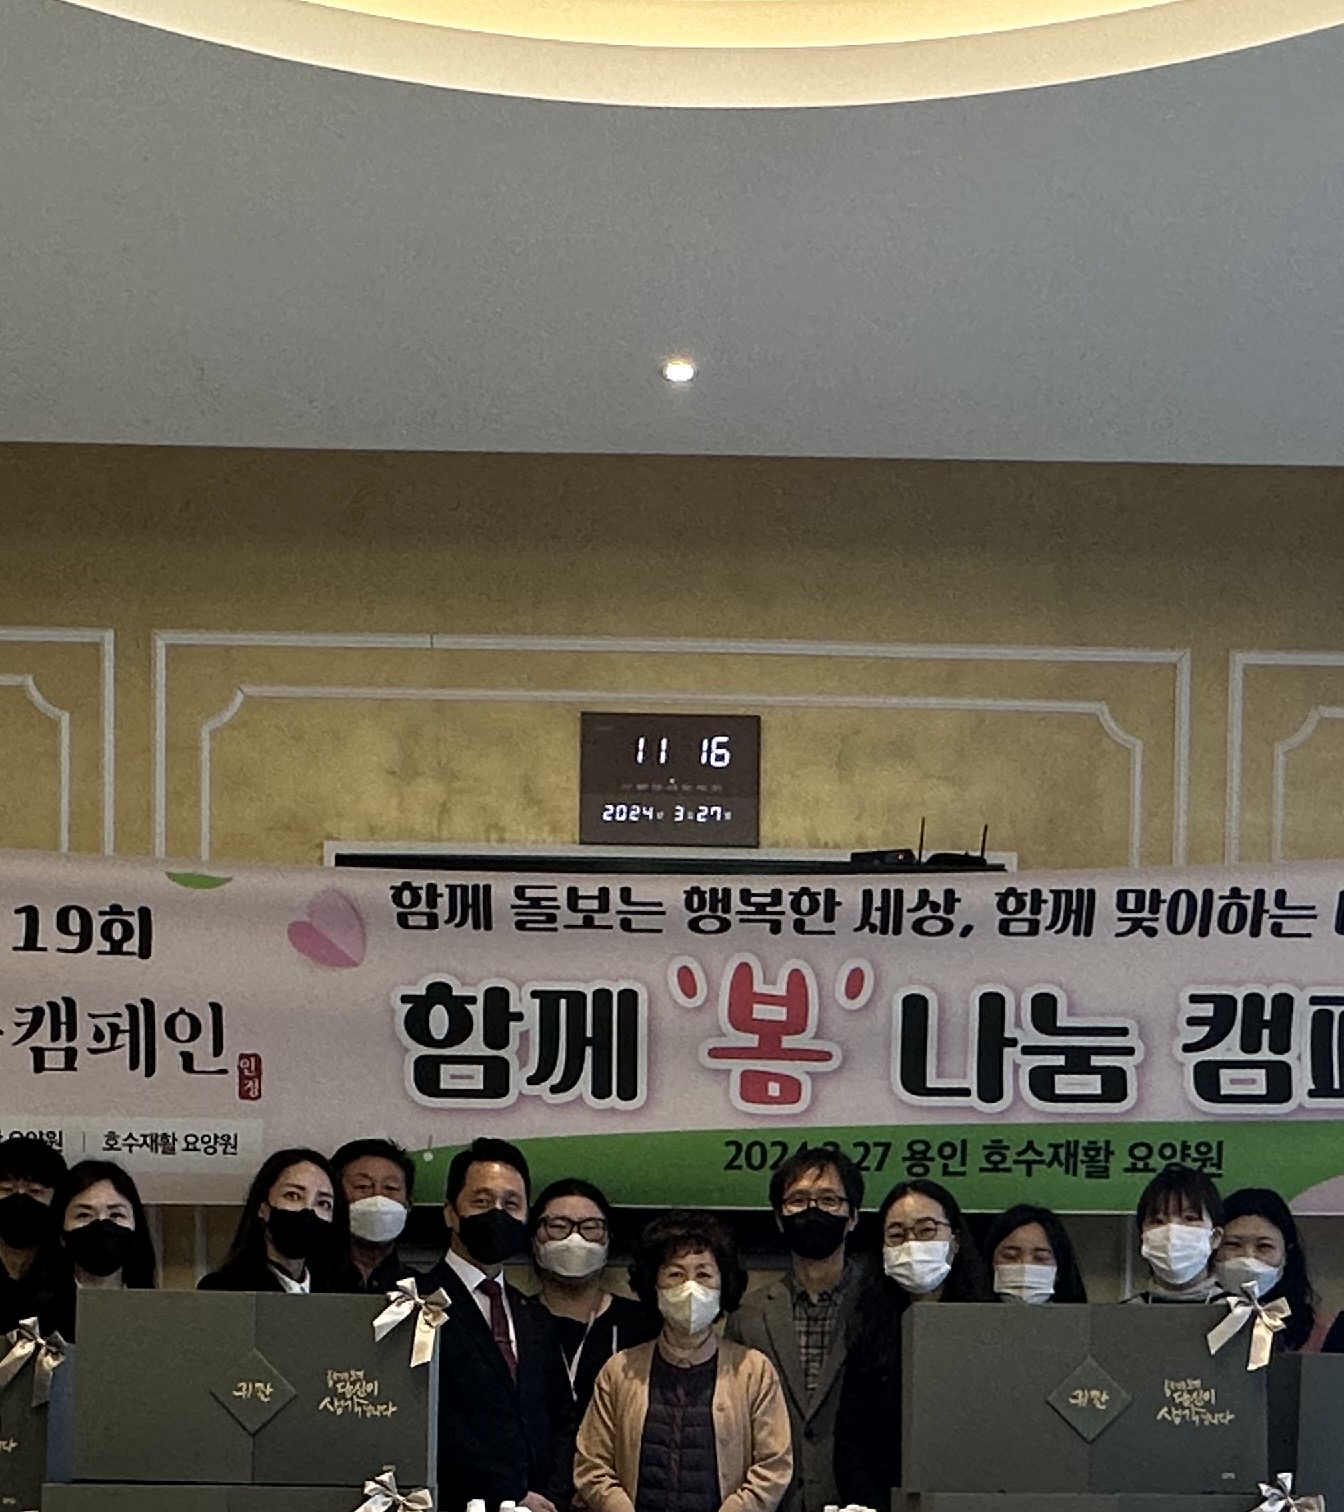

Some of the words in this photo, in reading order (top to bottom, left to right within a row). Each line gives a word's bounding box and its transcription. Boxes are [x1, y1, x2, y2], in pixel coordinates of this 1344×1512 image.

[636, 736, 668, 764] 11
[700, 736, 731, 768] 16
[12, 904, 152, 960] 19회
[390, 880, 493, 932] 함께
[510, 883, 666, 934] 돌보는
[683, 884, 842, 936] 행복한
[853, 886, 975, 938] 세상,
[995, 887, 1096, 937] 함께
[1114, 887, 1317, 939] 맞이하는
[398, 980, 644, 1102] 함께
[897, 991, 1136, 1106] 나눔
[102, 1130, 179, 1157] 호수재활
[181, 1131, 239, 1157] 요양원
[723, 1140, 892, 1172] 20227
[901, 1139, 968, 1178] 용인
[979, 1139, 1114, 1178] 호수재활
[1123, 1139, 1224, 1179] 요양원
